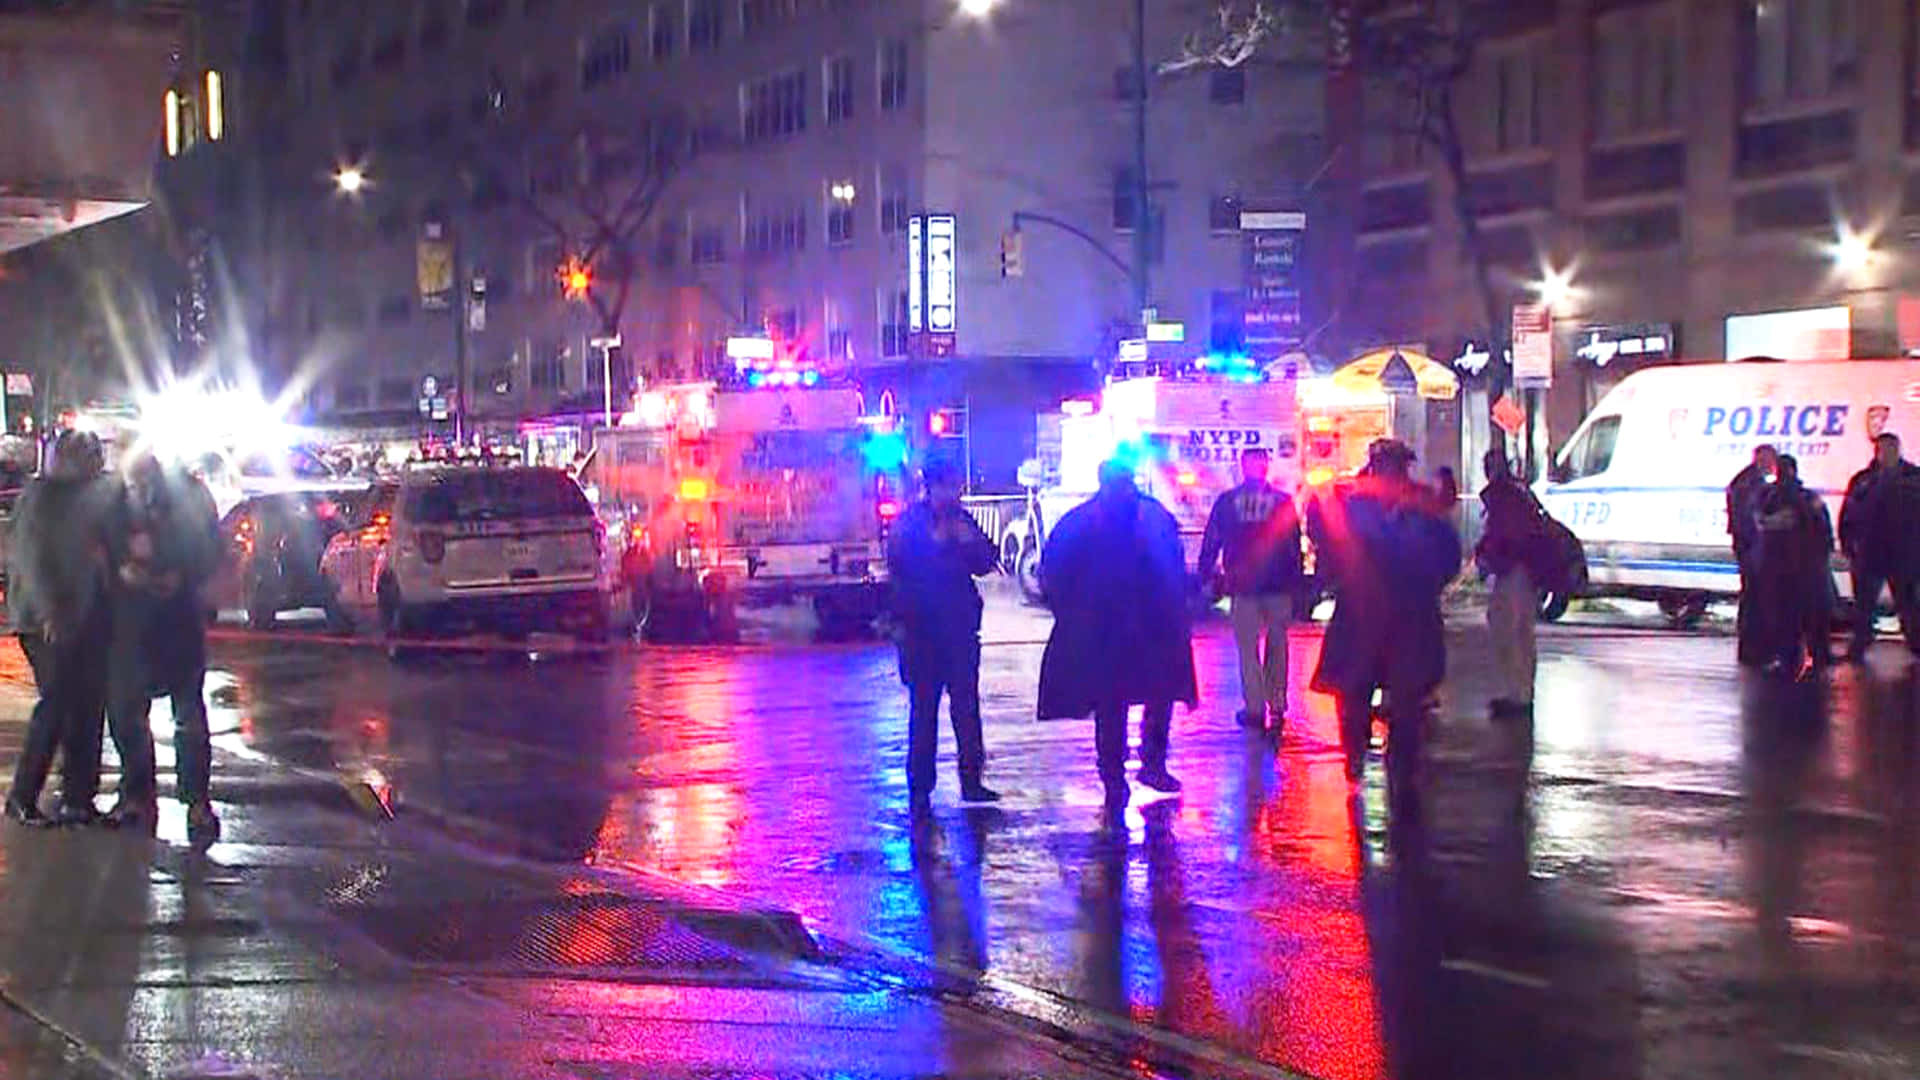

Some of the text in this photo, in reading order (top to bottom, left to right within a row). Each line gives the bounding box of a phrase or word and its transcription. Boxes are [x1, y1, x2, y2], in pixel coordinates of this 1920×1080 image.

[1703, 404, 1850, 437] POLICE
[1189, 430, 1261, 445] NYPD
[1179, 448, 1273, 462] POLI
